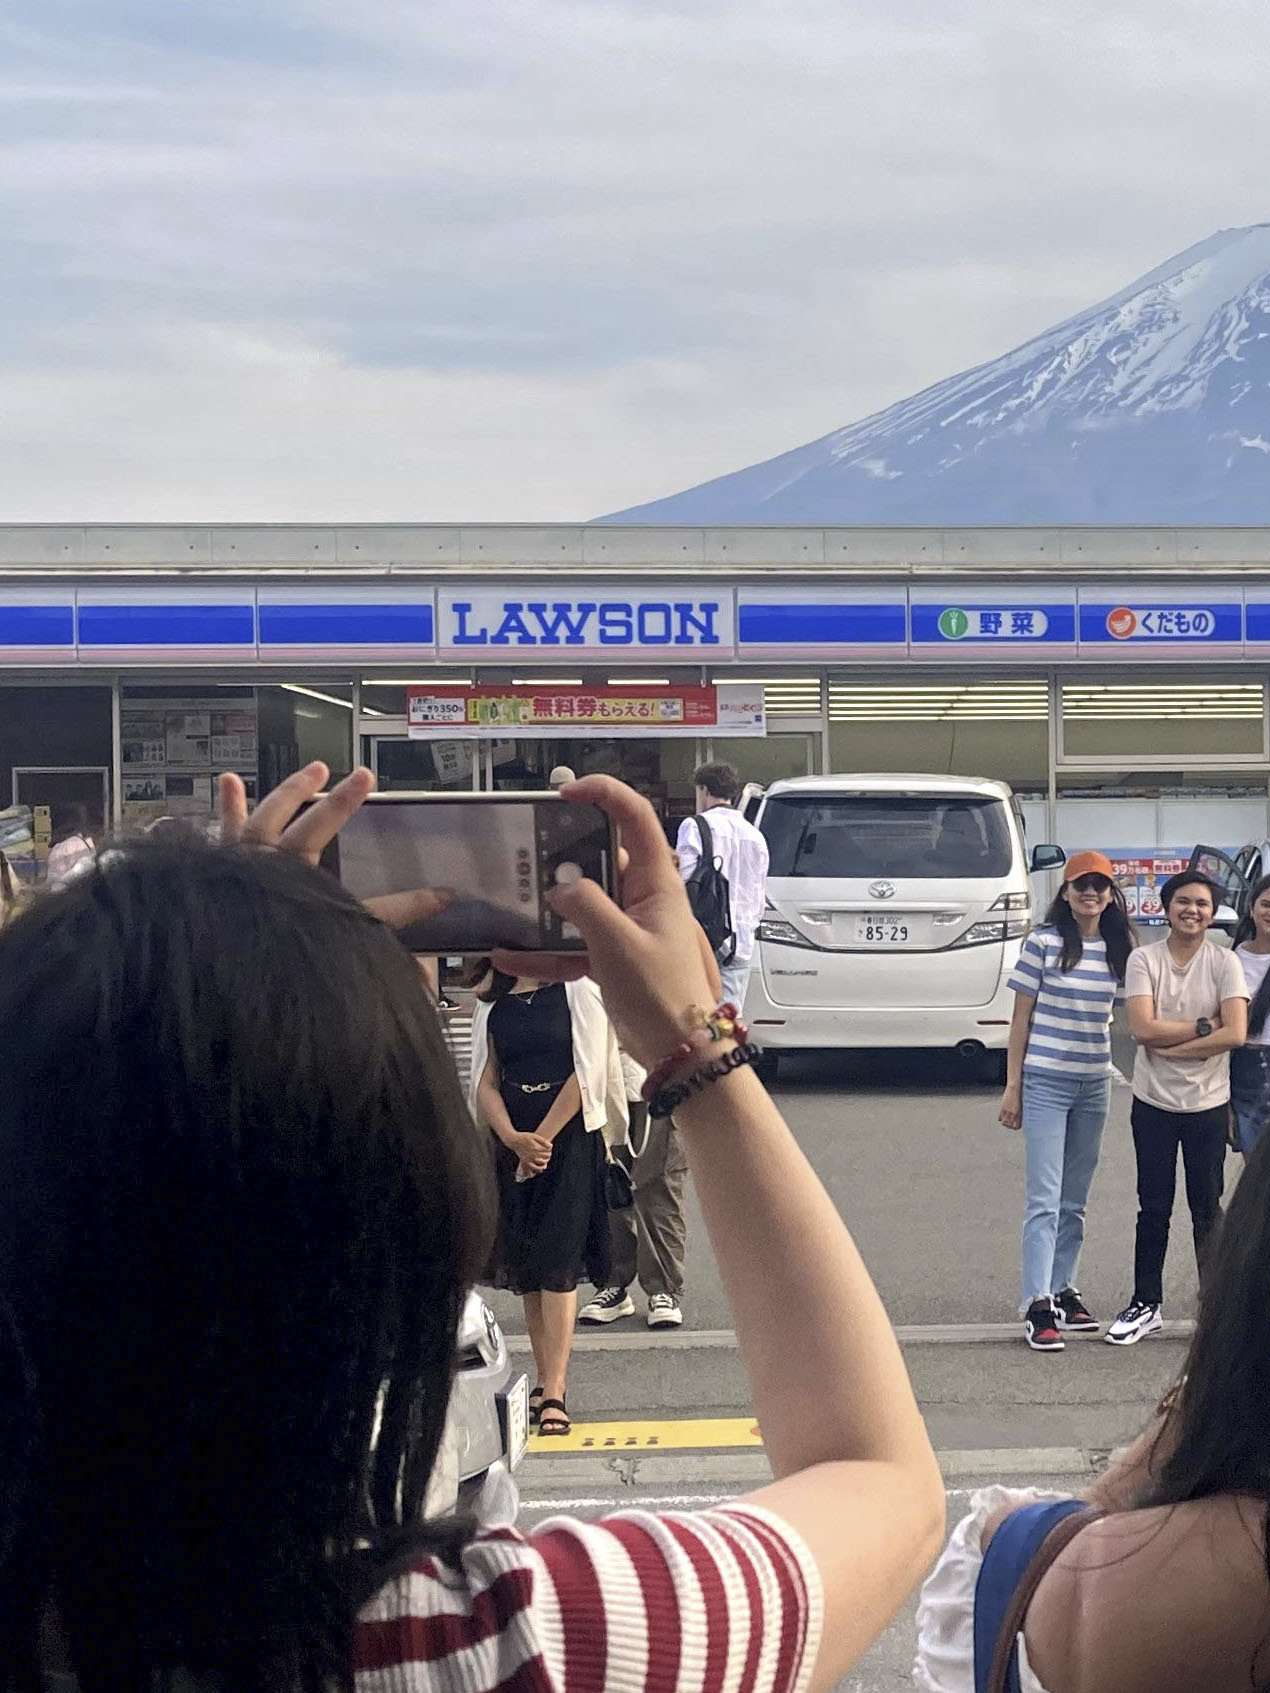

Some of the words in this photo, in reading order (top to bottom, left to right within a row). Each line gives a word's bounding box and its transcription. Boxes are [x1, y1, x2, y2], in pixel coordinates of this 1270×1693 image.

[452, 603, 719, 645] LAWSON
[979, 612, 1034, 634] 野菜
[1140, 612, 1209, 634] くだもの
[532, 697, 655, 718] 無料券もらえる!
[866, 926, 908, 941] 85-29
